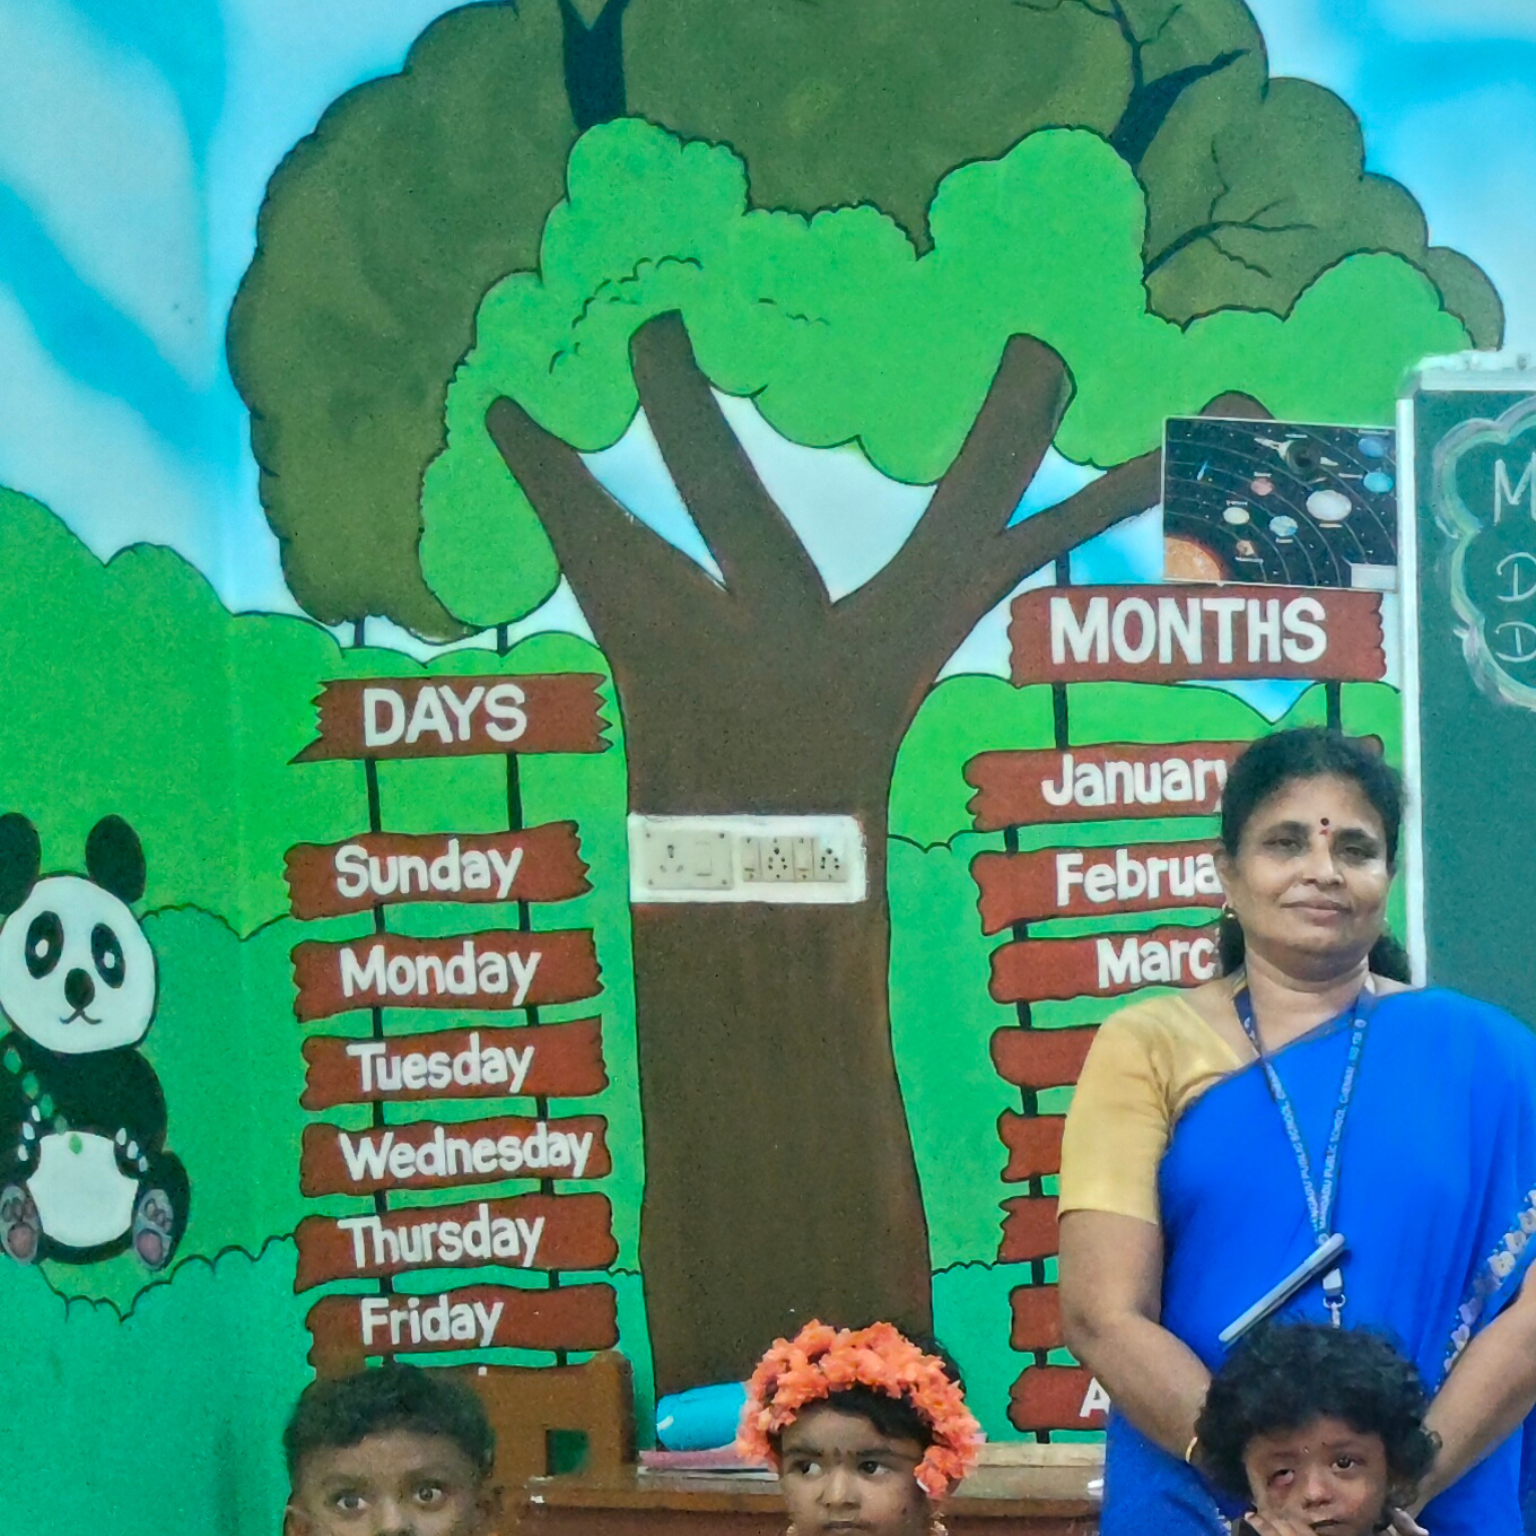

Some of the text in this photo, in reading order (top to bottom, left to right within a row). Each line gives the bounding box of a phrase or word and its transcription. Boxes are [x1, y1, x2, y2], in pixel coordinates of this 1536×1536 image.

[1050, 597, 1328, 665] MONTHS
[361, 683, 528, 747] DAYS
[334, 838, 525, 901] Sunday
[1054, 850, 1224, 907] Februa
[339, 940, 542, 1007] Monday
[1096, 936, 1216, 989] Marc
[346, 1032, 535, 1094] Tuesday
[338, 1122, 594, 1182] Wednesday
[1323, 1144, 1338, 1179] PUBLIC
[336, 1203, 545, 1268] Thursday
[360, 1294, 504, 1347] Friday
